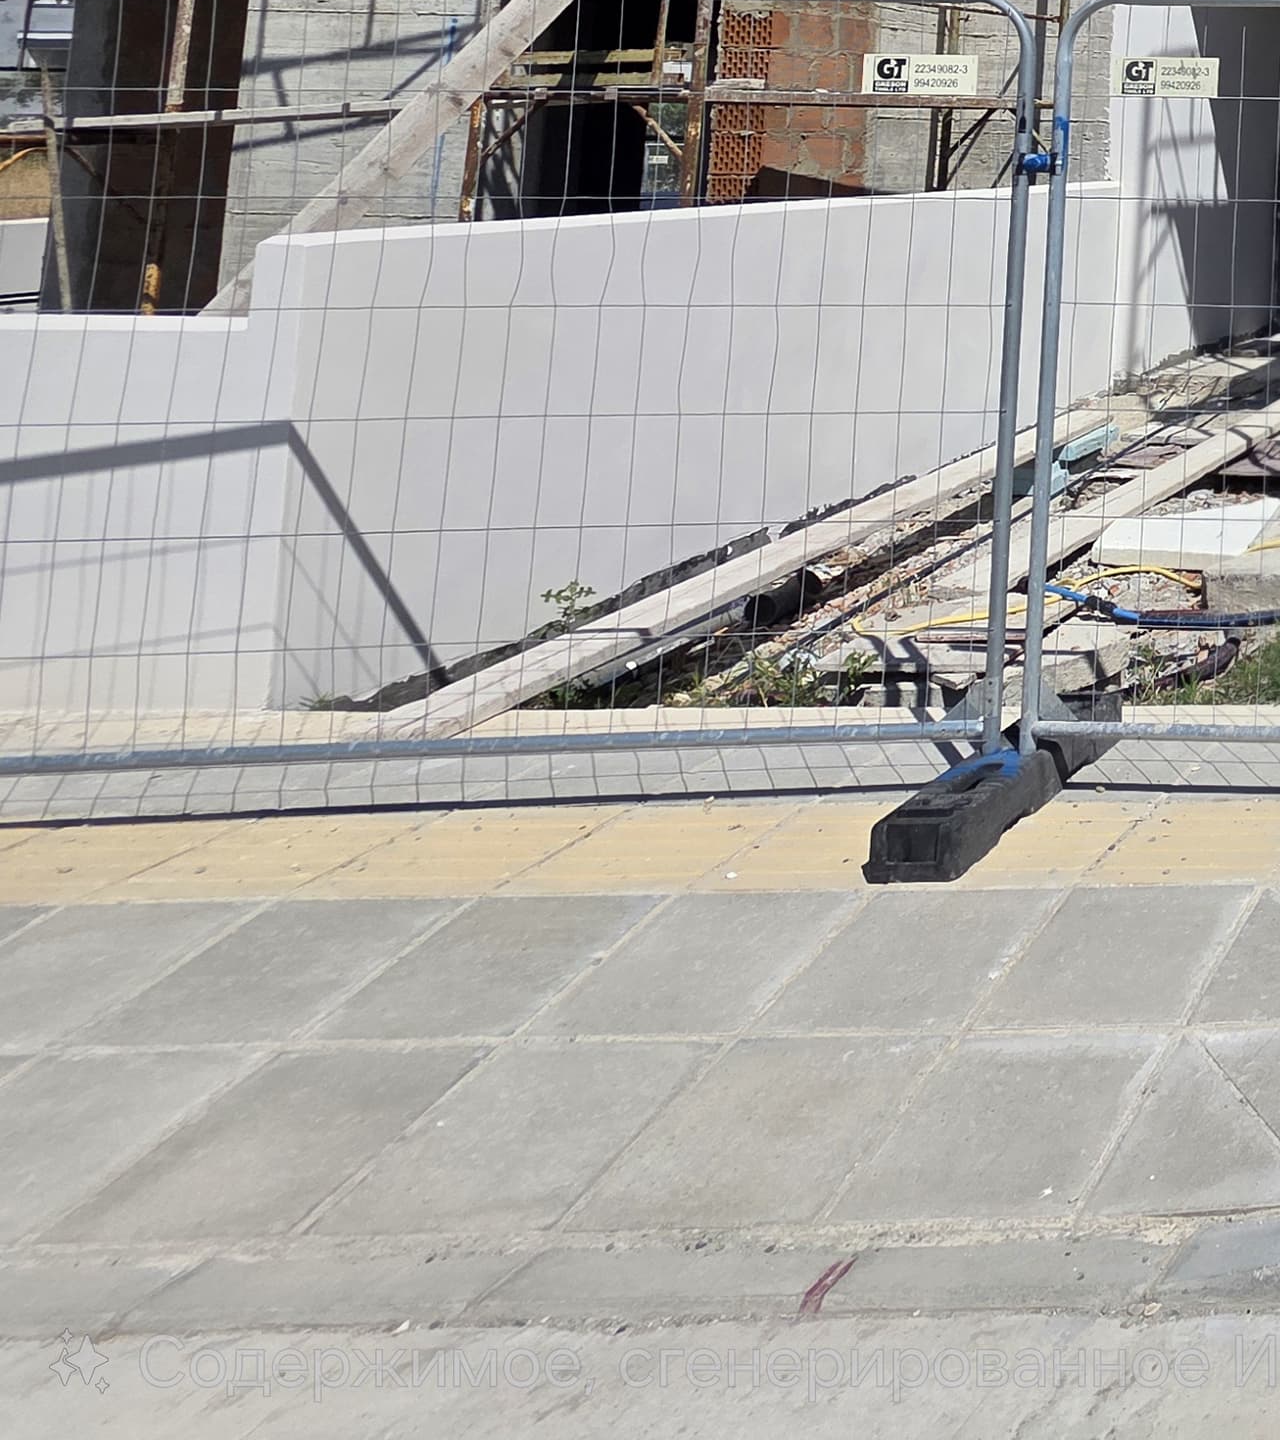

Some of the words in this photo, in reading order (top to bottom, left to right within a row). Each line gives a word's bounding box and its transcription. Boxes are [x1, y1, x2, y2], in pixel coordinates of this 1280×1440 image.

[877, 58, 906, 79] GT
[914, 64, 968, 74] 22349082-3
[1125, 61, 1154, 81] GT
[913, 78, 958, 88] 99420926
[1160, 80, 1201, 90] 99420926
